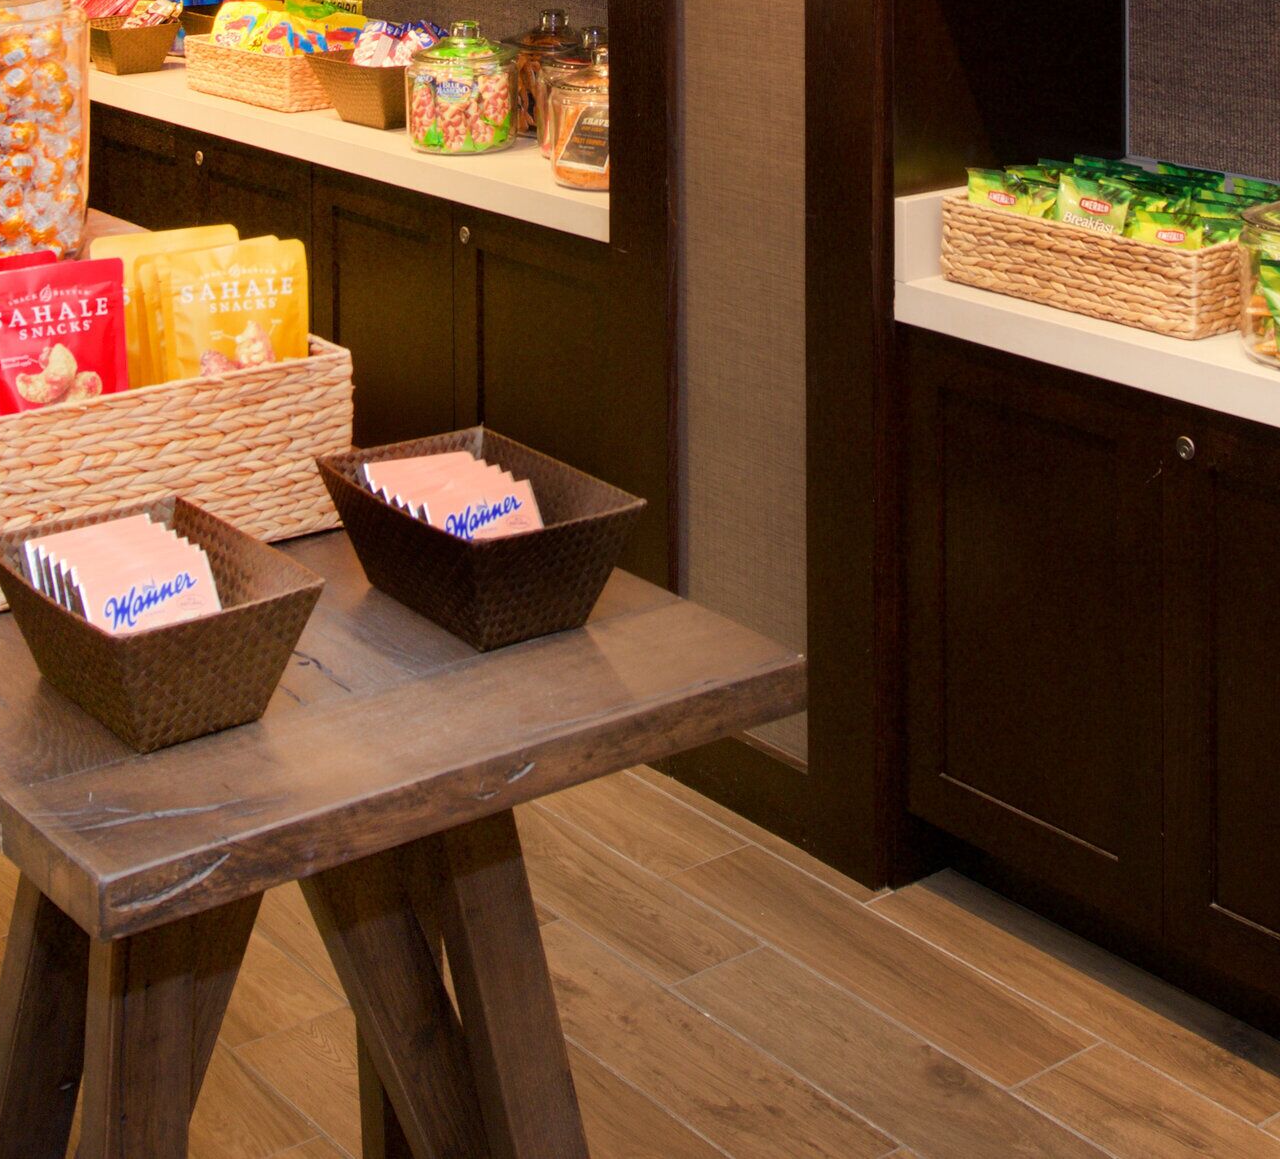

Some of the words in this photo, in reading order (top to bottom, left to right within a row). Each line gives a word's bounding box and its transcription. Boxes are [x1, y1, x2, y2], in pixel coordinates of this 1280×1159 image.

[1063, 212, 1115, 233] Breakfast
[180, 276, 293, 304] SAHALE
[210, 298, 276, 313] SNACKS
[19, 320, 91, 340] SNACKS
[445, 496, 522, 542] Manner
[104, 572, 198, 630] Manner
